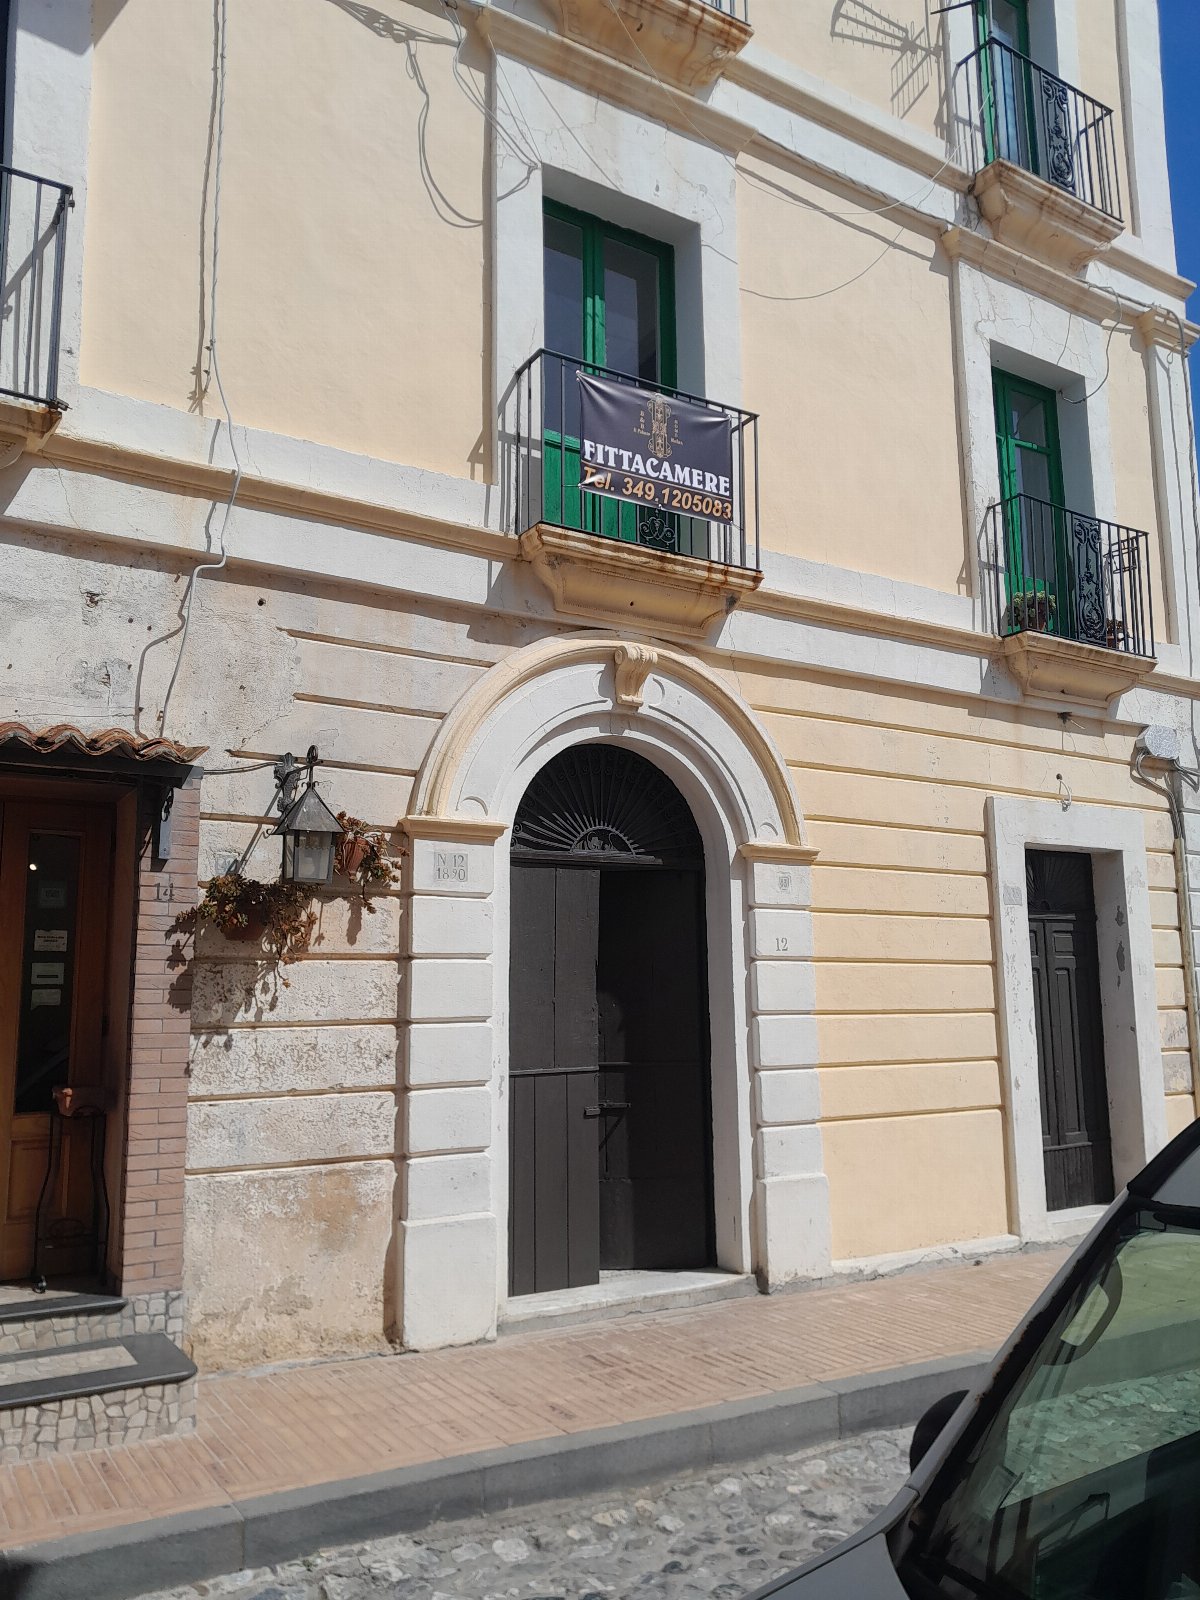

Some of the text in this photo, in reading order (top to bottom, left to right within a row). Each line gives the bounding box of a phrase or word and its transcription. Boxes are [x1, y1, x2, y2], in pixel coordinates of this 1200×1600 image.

[583, 439, 730, 496] FITTACAMERE
[584, 466, 732, 519] Tel. 349.1205083
[453, 854, 465, 868] 12
[436, 867, 466, 881] 1890
[153, 882, 175, 901] 14
[775, 937, 788, 951] 12
